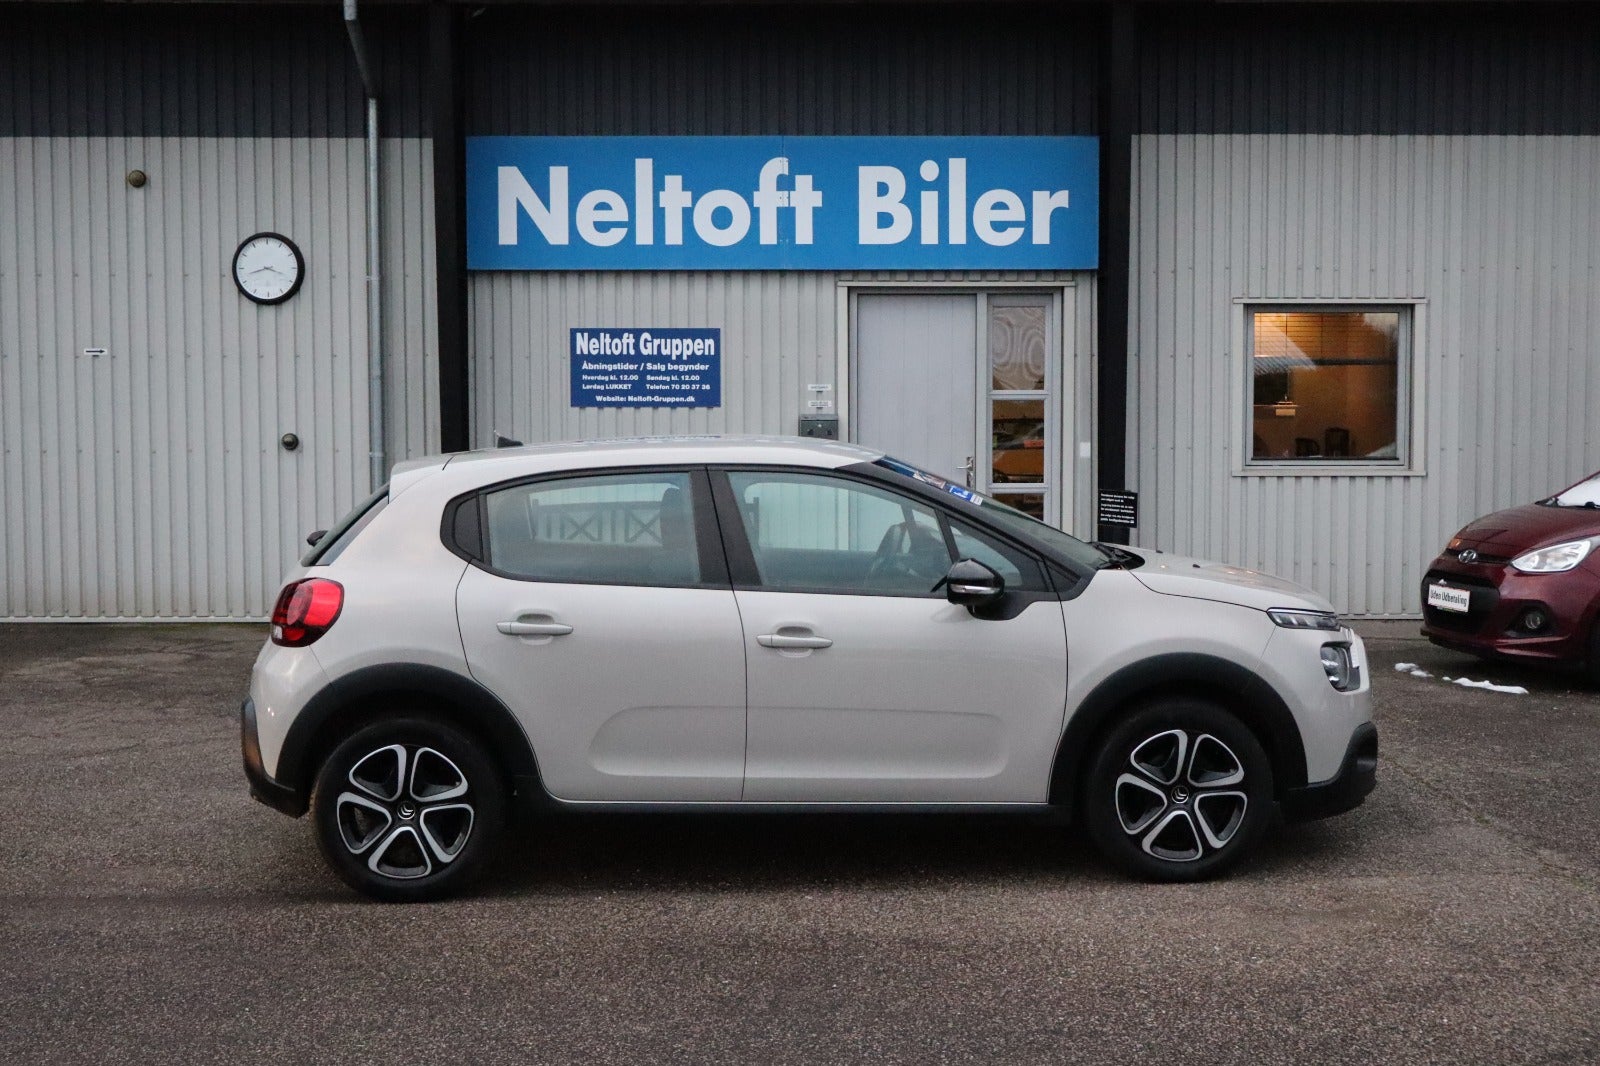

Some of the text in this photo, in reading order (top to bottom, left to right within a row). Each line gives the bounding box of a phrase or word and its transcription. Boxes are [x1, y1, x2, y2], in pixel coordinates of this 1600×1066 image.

[497, 157, 1069, 247] Neltoft Biler
[576, 332, 715, 360] Neltoft Gruppen
[582, 360, 710, 371] Åbningstider / Salg begynder
[628, 395, 695, 403] Neltoft-Gruppen.dk
